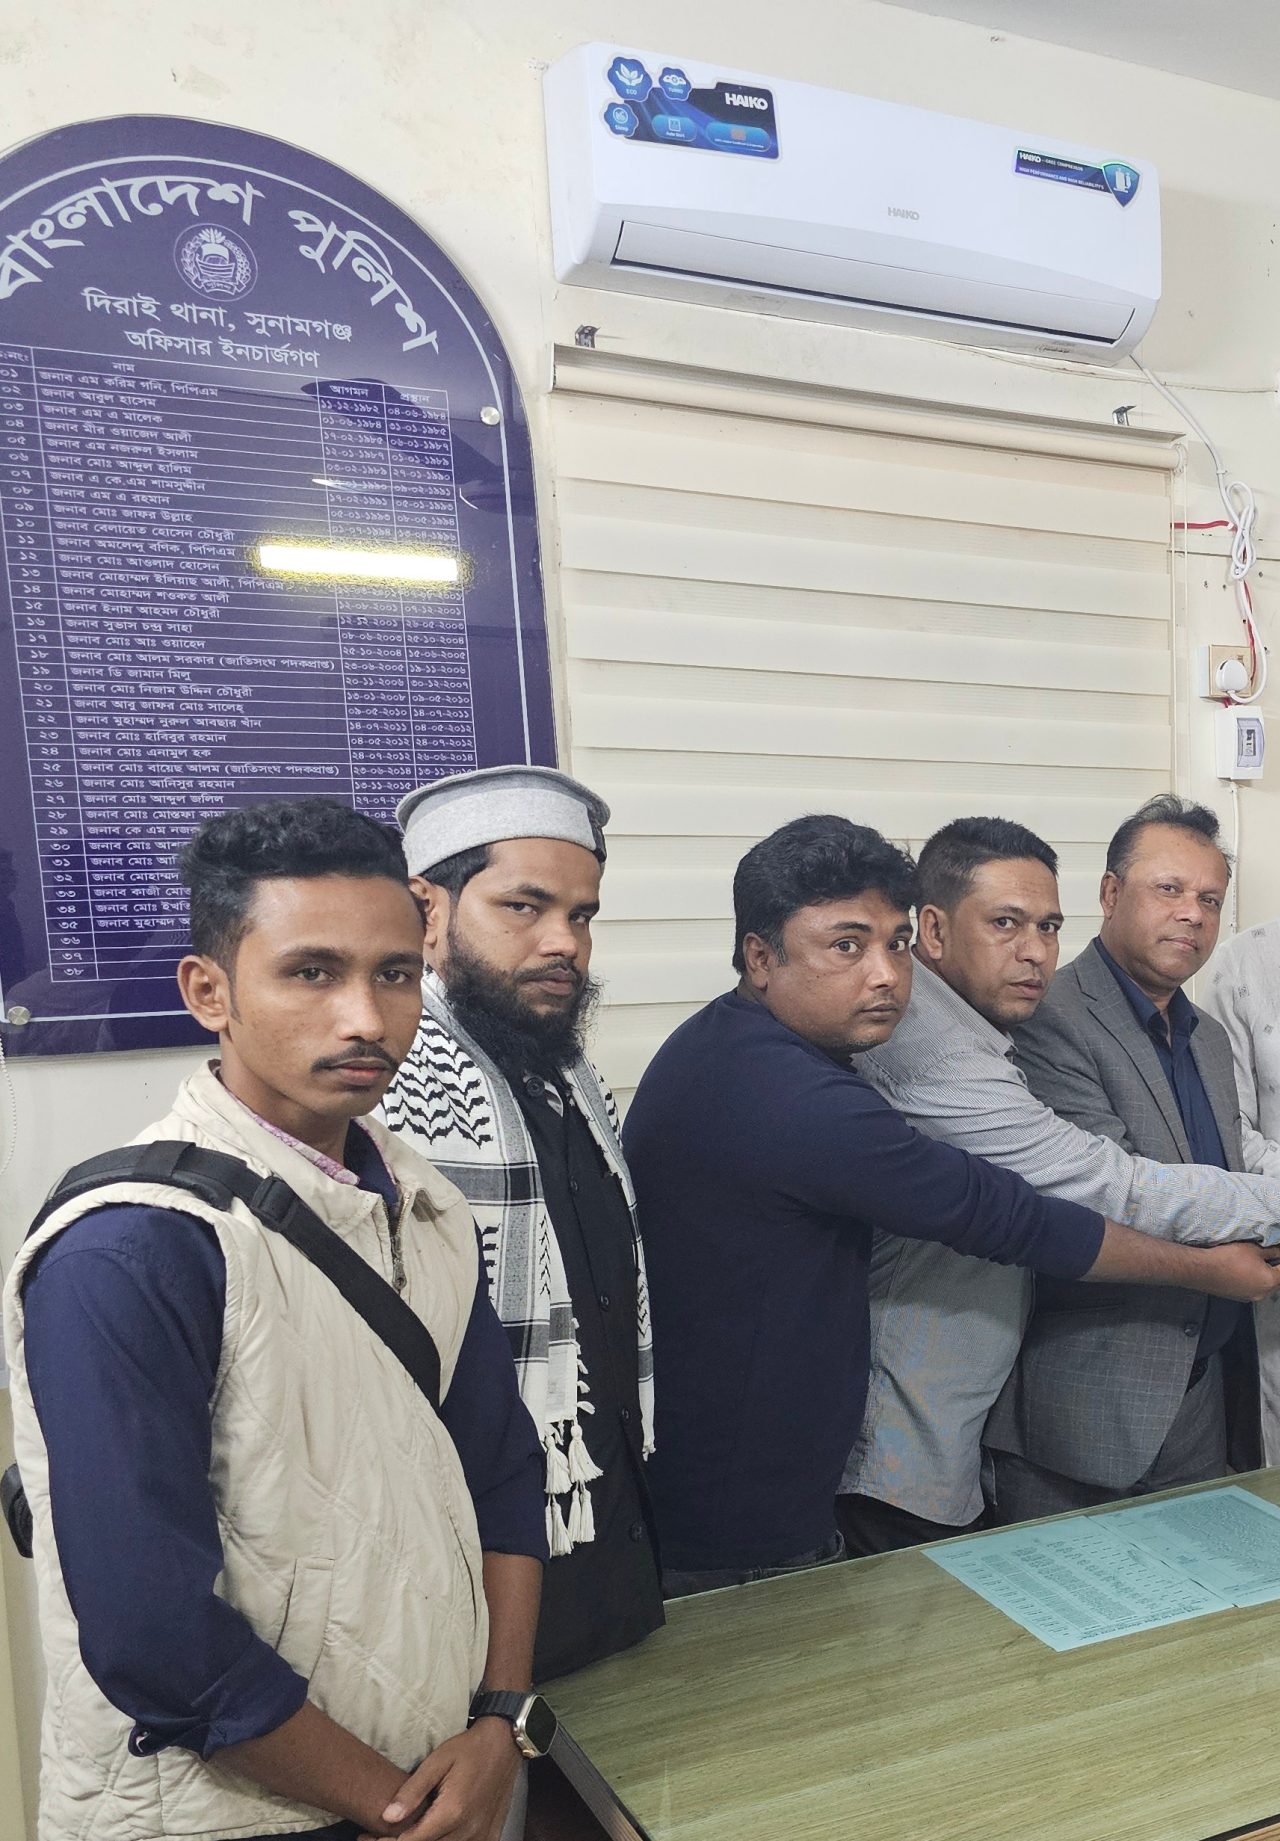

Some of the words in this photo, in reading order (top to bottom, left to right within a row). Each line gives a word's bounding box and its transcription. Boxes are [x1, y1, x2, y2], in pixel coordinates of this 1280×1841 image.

[725, 92, 768, 110] HAIKO
[1019, 152, 1041, 163] HAIKO
[887, 206, 919, 220] HAIKO
[0, 176, 264, 299] বাংলাদেশ
[288, 209, 438, 354] পুলিশ
[81, 286, 160, 321] দিরাই
[170, 303, 236, 332] থানা,
[244, 310, 352, 343] সুনামগঞ্জ
[125, 328, 211, 356] অফিসার
[220, 335, 320, 369] ইনচার্জগণ
[0, 368, 18, 378] ০১
[38, 371, 73, 382] জনাব
[78, 375, 99, 384] এম
[103, 376, 136, 388] করিম
[170, 382, 218, 397] পিপিএম
[112, 362, 135, 372] নাম
[329, 385, 369, 397] আগমন
[0, 385, 22, 395] ০২
[41, 388, 75, 399] জনাব
[78, 391, 114, 404] আবুল
[118, 395, 156, 407] হাসেম
[3, 402, 24, 411] ০৩
[42, 405, 77, 415] জনাব
[82, 409, 102, 417] এম
[107, 411, 118, 419] এ
[122, 412, 163, 423] মালেক
[5, 419, 24, 427] ০৪
[44, 421, 78, 432] জনাব
[82, 422, 105, 434] মীর
[162, 431, 192, 442] আলী
[7, 436, 26, 445] ০৫
[45, 438, 80, 448] জনাব
[85, 442, 106, 450] এম
[109, 443, 152, 455] নজরুল
[156, 446, 198, 458] ইসলাম
[14, 502, 34, 511] ০৯
[52, 504, 87, 515] জনাব
[92, 507, 117, 516] মোঃ
[121, 509, 156, 519] জাফর
[160, 510, 193, 523] উল্লাহ
[16, 518, 35, 527] ১০
[54, 521, 89, 531] জনাব
[93, 524, 147, 534] বেলায়েত
[152, 527, 193, 537] হোসেন
[197, 529, 235, 541] চৌধুরী
[18, 535, 35, 544] ১১
[56, 537, 91, 547] জনাব
[188, 543, 236, 556] পিপিএম
[20, 551, 39, 561] ১২
[58, 554, 92, 563] জনাব
[97, 556, 122, 565] মোঃ
[179, 561, 220, 571] হোসেন
[23, 584, 41, 593] ১৪
[61, 586, 96, 596] জনাব
[100, 588, 152, 599] মোহাম্মদ
[155, 591, 197, 600] শওকত
[200, 592, 230, 603] আলী
[25, 601, 43, 610] ১৫
[63, 603, 97, 612] জনাব
[101, 602, 133, 614] ইনাম
[136, 606, 179, 616] আহমদ
[183, 607, 220, 619] চৌধুরী
[27, 617, 45, 626] ১৬
[64, 619, 99, 628] জনাব
[102, 620, 137, 631] সুভাস
[141, 622, 162, 632] চন্দ্র
[166, 623, 193, 633] সাহা
[29, 633, 48, 643] ১৭
[66, 635, 101, 644] জনাব
[105, 636, 130, 646] মোঃ
[133, 637, 156, 646] আঃ
[161, 639, 206, 648] ওয়াহেদ
[30, 649, 49, 658] ১৮
[68, 651, 103, 660] জনাব
[107, 653, 132, 661] মোঃ
[135, 654, 171, 663] আলম
[174, 655, 214, 664] সরকার
[32, 666, 50, 675] ১৯
[70, 667, 104, 676] জনাব
[108, 666, 122, 677] ডি
[126, 669, 164, 678] জামান
[167, 668, 192, 681] মিলু
[33, 682, 53, 691] ২০
[71, 683, 106, 692] জনাব
[110, 684, 135, 693] মোঃ
[138, 683, 176, 694] নিজাম
[179, 685, 212, 695] উদ্দিন
[216, 686, 253, 698] চৌধুরী
[36, 698, 53, 707] ২১
[73, 699, 107, 708] জনাব
[110, 700, 137, 711] আবু
[139, 701, 175, 710] জাফর
[179, 702, 204, 711] মোঃ
[37, 714, 57, 724] ২২
[75, 716, 109, 724] জনাব
[112, 716, 155, 726] মুহাম্মদ
[158, 717, 190, 727] নুরুল
[39, 731, 59, 739] ২৩
[76, 731, 111, 740] জনাব
[115, 732, 140, 741] মোঃ
[143, 731, 185, 743] হাবিবুর
[188, 733, 227, 742] রহমান
[41, 747, 59, 755] ২৪
[78, 747, 112, 755] জনাব
[117, 748, 142, 756] মোঃ
[146, 749, 188, 758] এনামুল
[191, 749, 212, 758] হক
[60, 936, 80, 944] ৩৬
[61, 952, 83, 960] ৩৭
[63, 968, 84, 976] ৩৮
